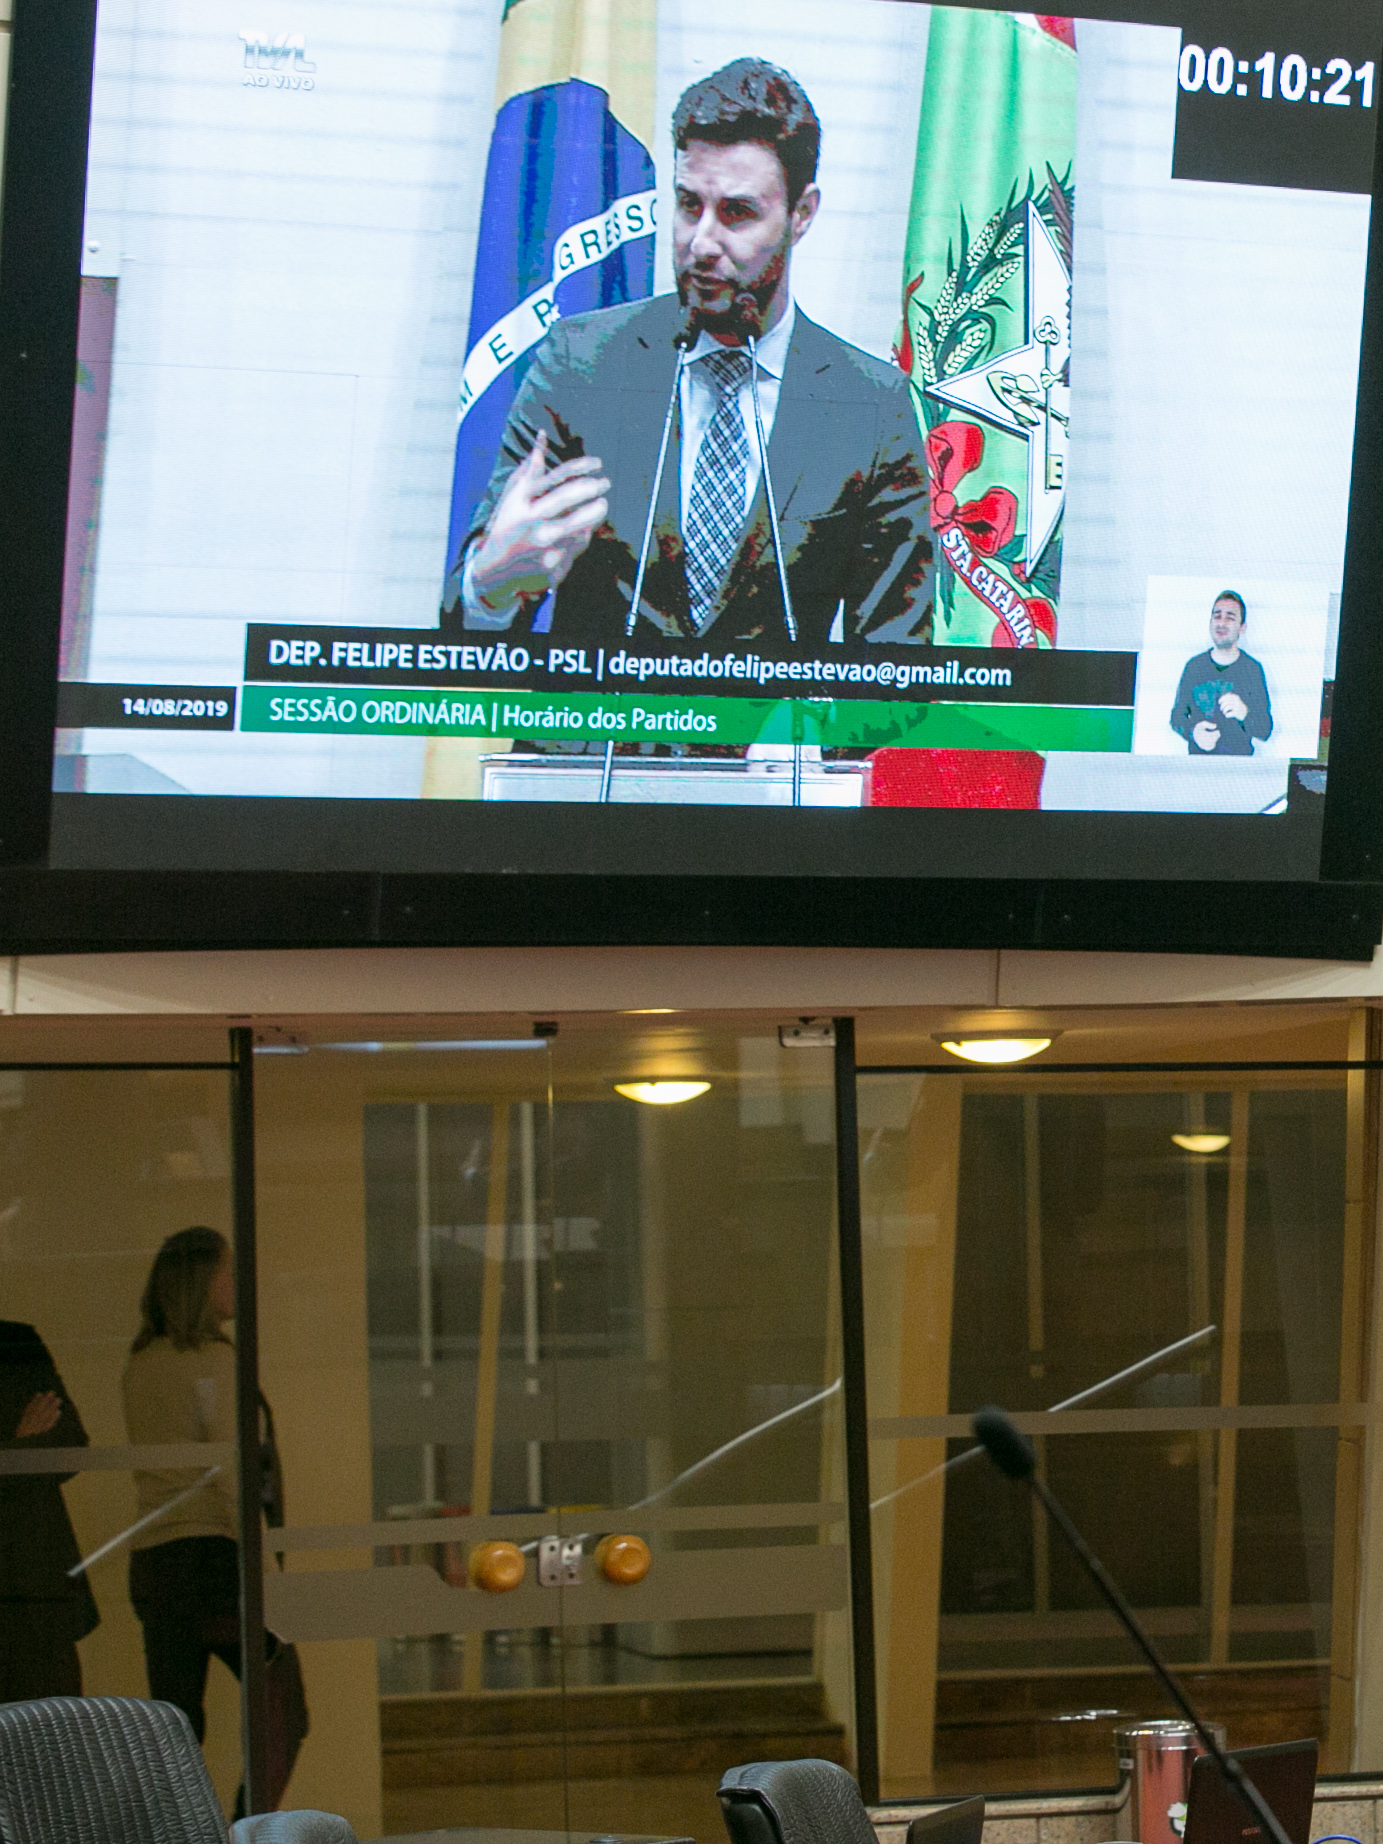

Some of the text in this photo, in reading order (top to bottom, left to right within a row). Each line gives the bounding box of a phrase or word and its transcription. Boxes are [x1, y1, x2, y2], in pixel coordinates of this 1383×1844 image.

[243, 73, 315, 91] AO VIVO
[1179, 44, 1375, 108] 00:10:21
[970, 565, 1035, 649] CATARIN
[268, 639, 328, 666] DEP.
[332, 642, 413, 669] FELIPE
[417, 642, 530, 672] ESTEVÃO
[548, 648, 592, 674] PSL
[608, 649, 1012, 688] deputadofelipeestevao@gmail.com
[121, 698, 229, 717] 14/08/2019
[269, 696, 357, 723] SESSÃO
[361, 697, 487, 726] ORDINÁRIA
[503, 704, 583, 728] Horário
[587, 706, 627, 730] dos
[631, 707, 718, 732] Partidos
